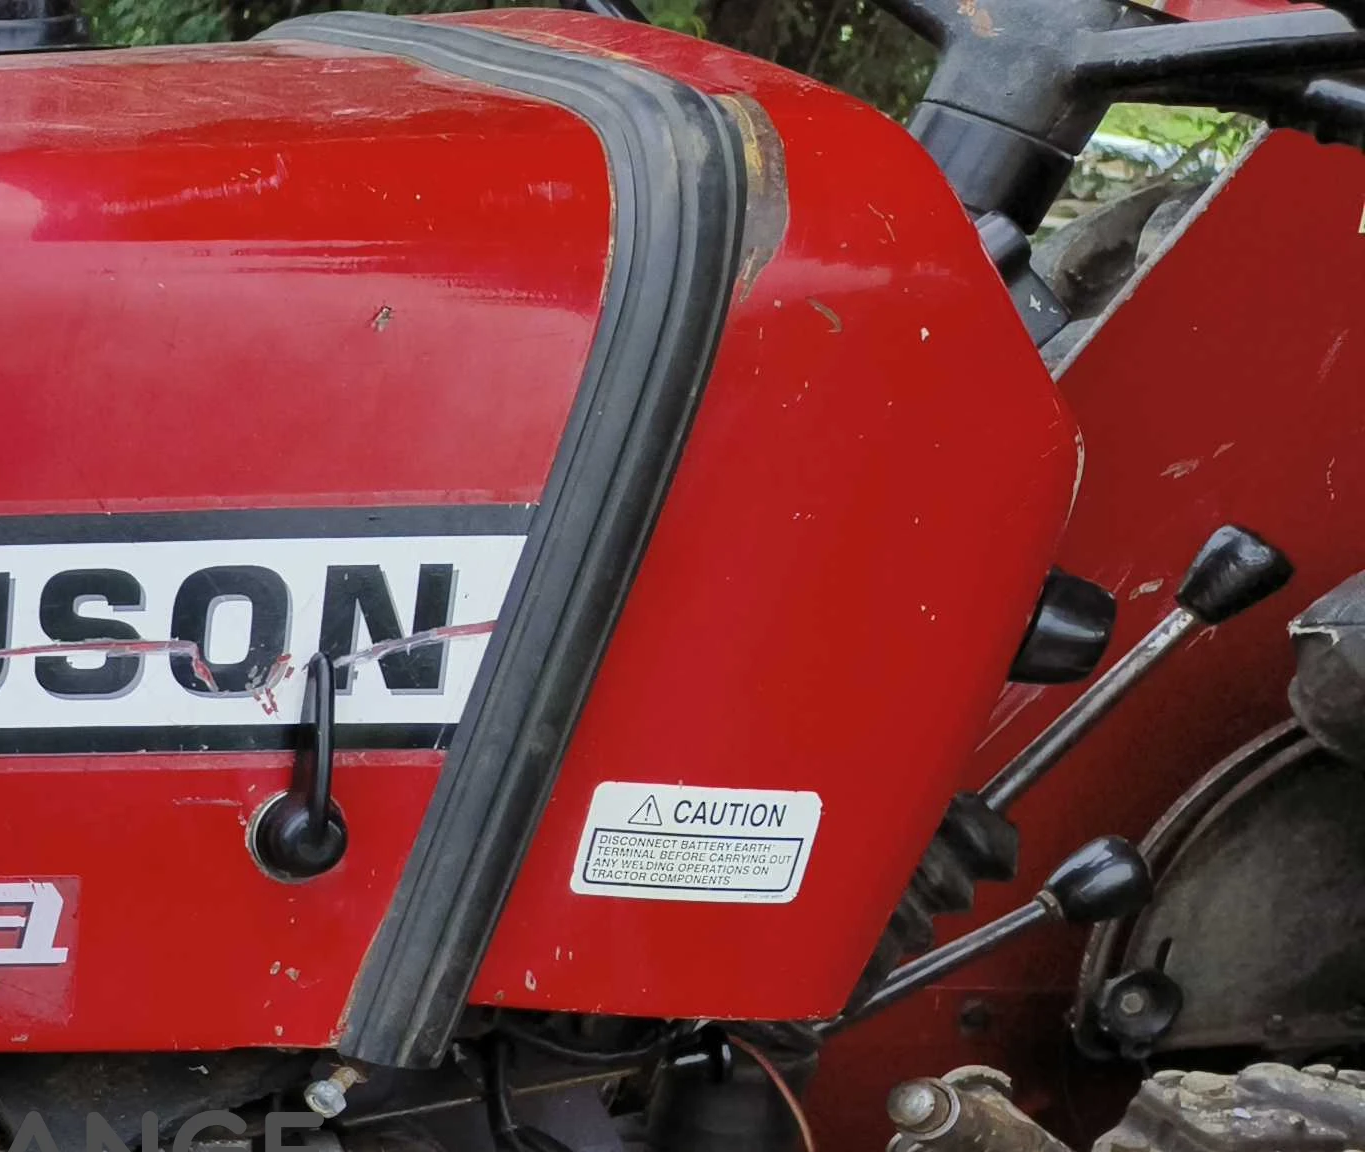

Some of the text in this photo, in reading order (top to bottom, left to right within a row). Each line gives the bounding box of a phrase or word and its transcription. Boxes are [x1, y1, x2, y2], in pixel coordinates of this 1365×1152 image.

[673, 800, 788, 828] CAUTION
[599, 834, 772, 852] DISCONNECT BATTERY EARTH
[597, 846, 792, 865] TERMINAL BEFORE CARRYING OUT
[592, 858, 770, 875] ANY WELDING OPERATIONS ON
[591, 869, 731, 885] TRACTOR COMPONENTS
